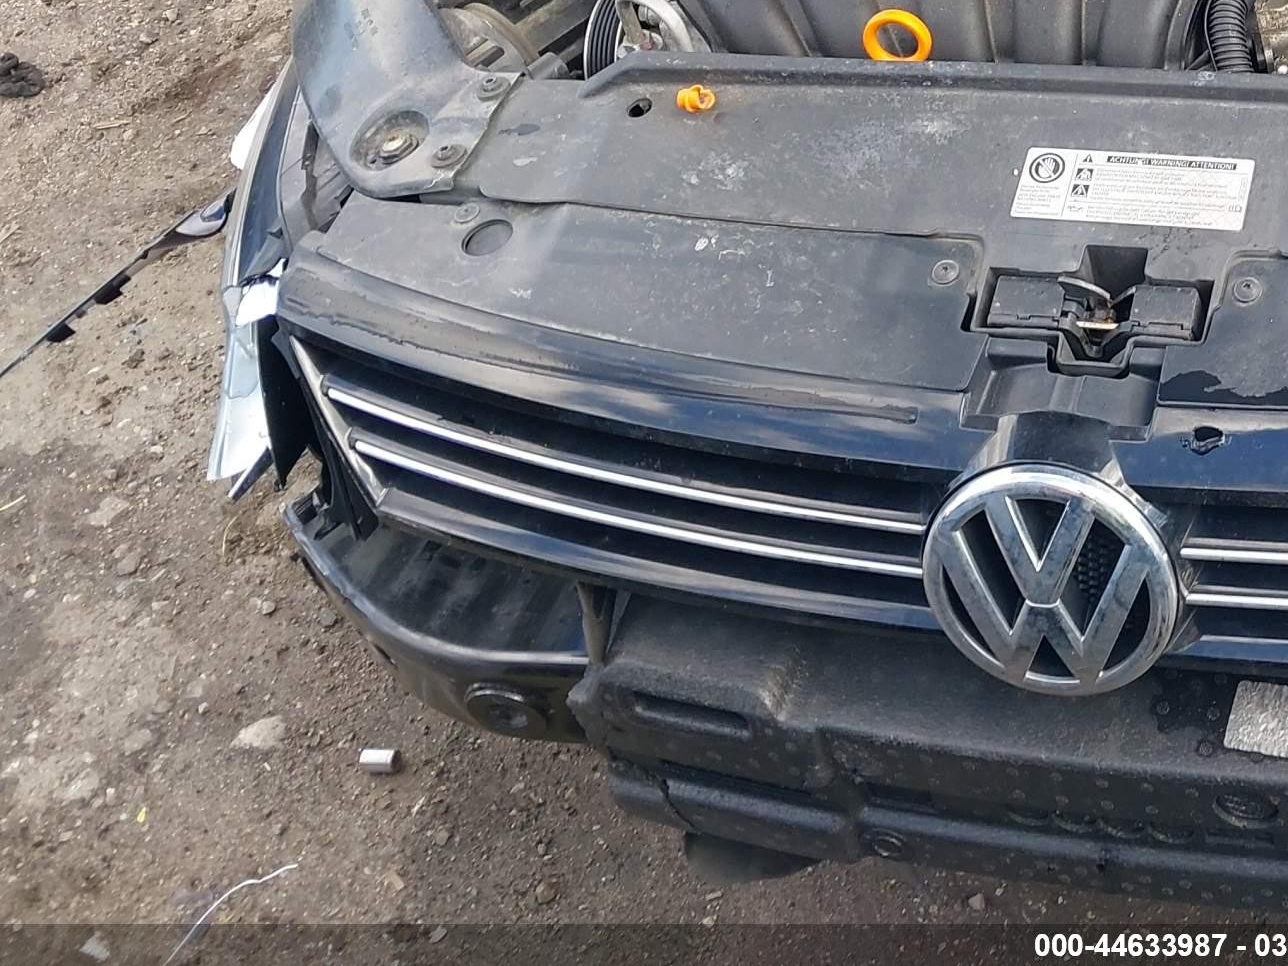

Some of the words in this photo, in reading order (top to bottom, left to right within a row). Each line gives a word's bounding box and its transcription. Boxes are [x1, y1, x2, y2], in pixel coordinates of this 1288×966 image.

[1150, 158, 1190, 168] WARNING!
[1191, 161, 1236, 171] ATTENTION!
[933, 482, 1160, 686] VW
